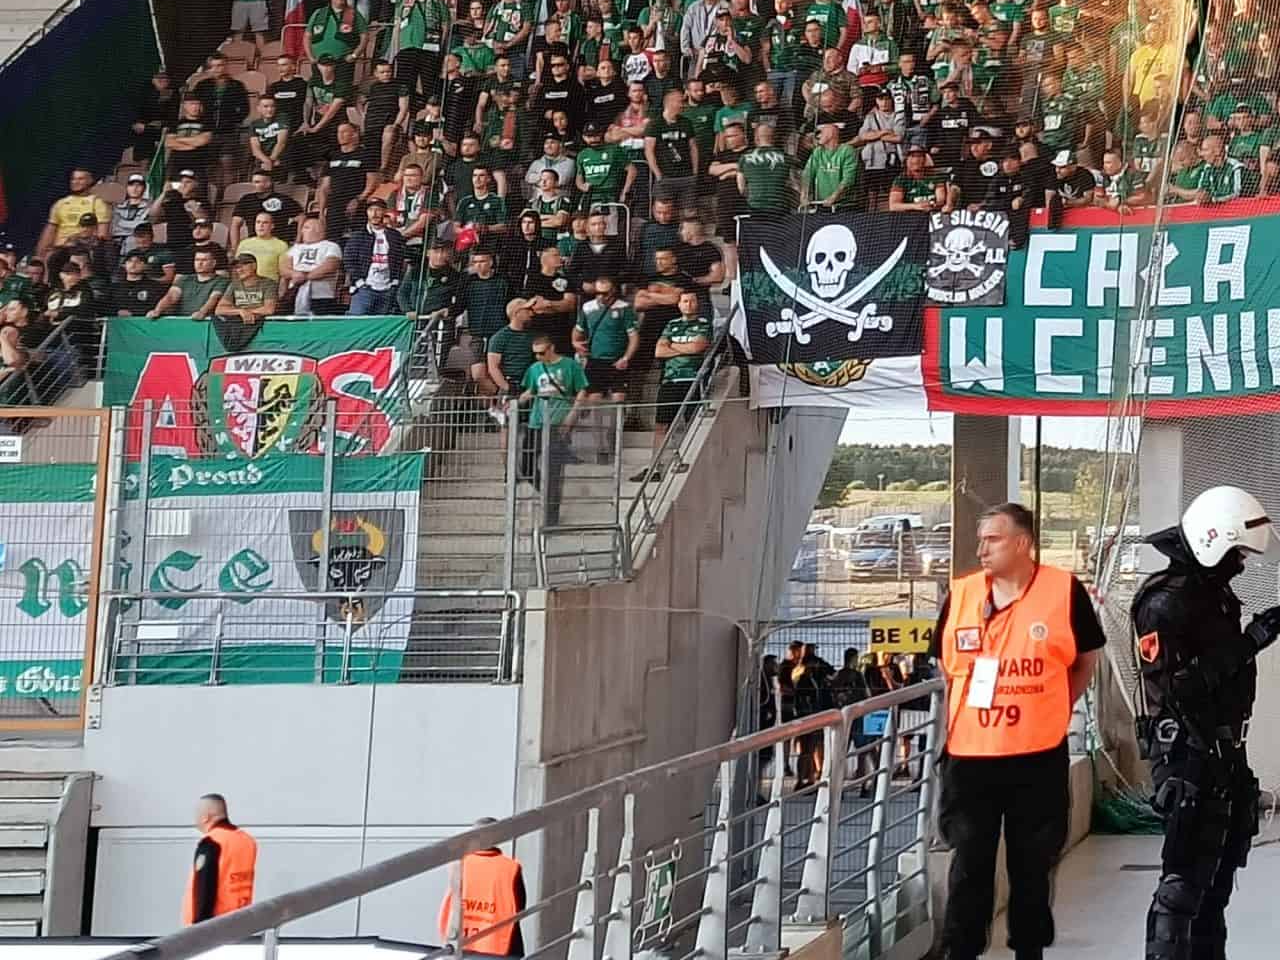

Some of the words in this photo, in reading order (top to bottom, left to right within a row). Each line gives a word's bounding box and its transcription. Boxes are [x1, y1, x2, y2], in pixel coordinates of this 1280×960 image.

[949, 208, 1010, 238] SILESIA
[1023, 223, 1252, 308] CAŁA
[949, 317, 1004, 392] W
[871, 628, 901, 644] BE
[978, 704, 1021, 729] 079
